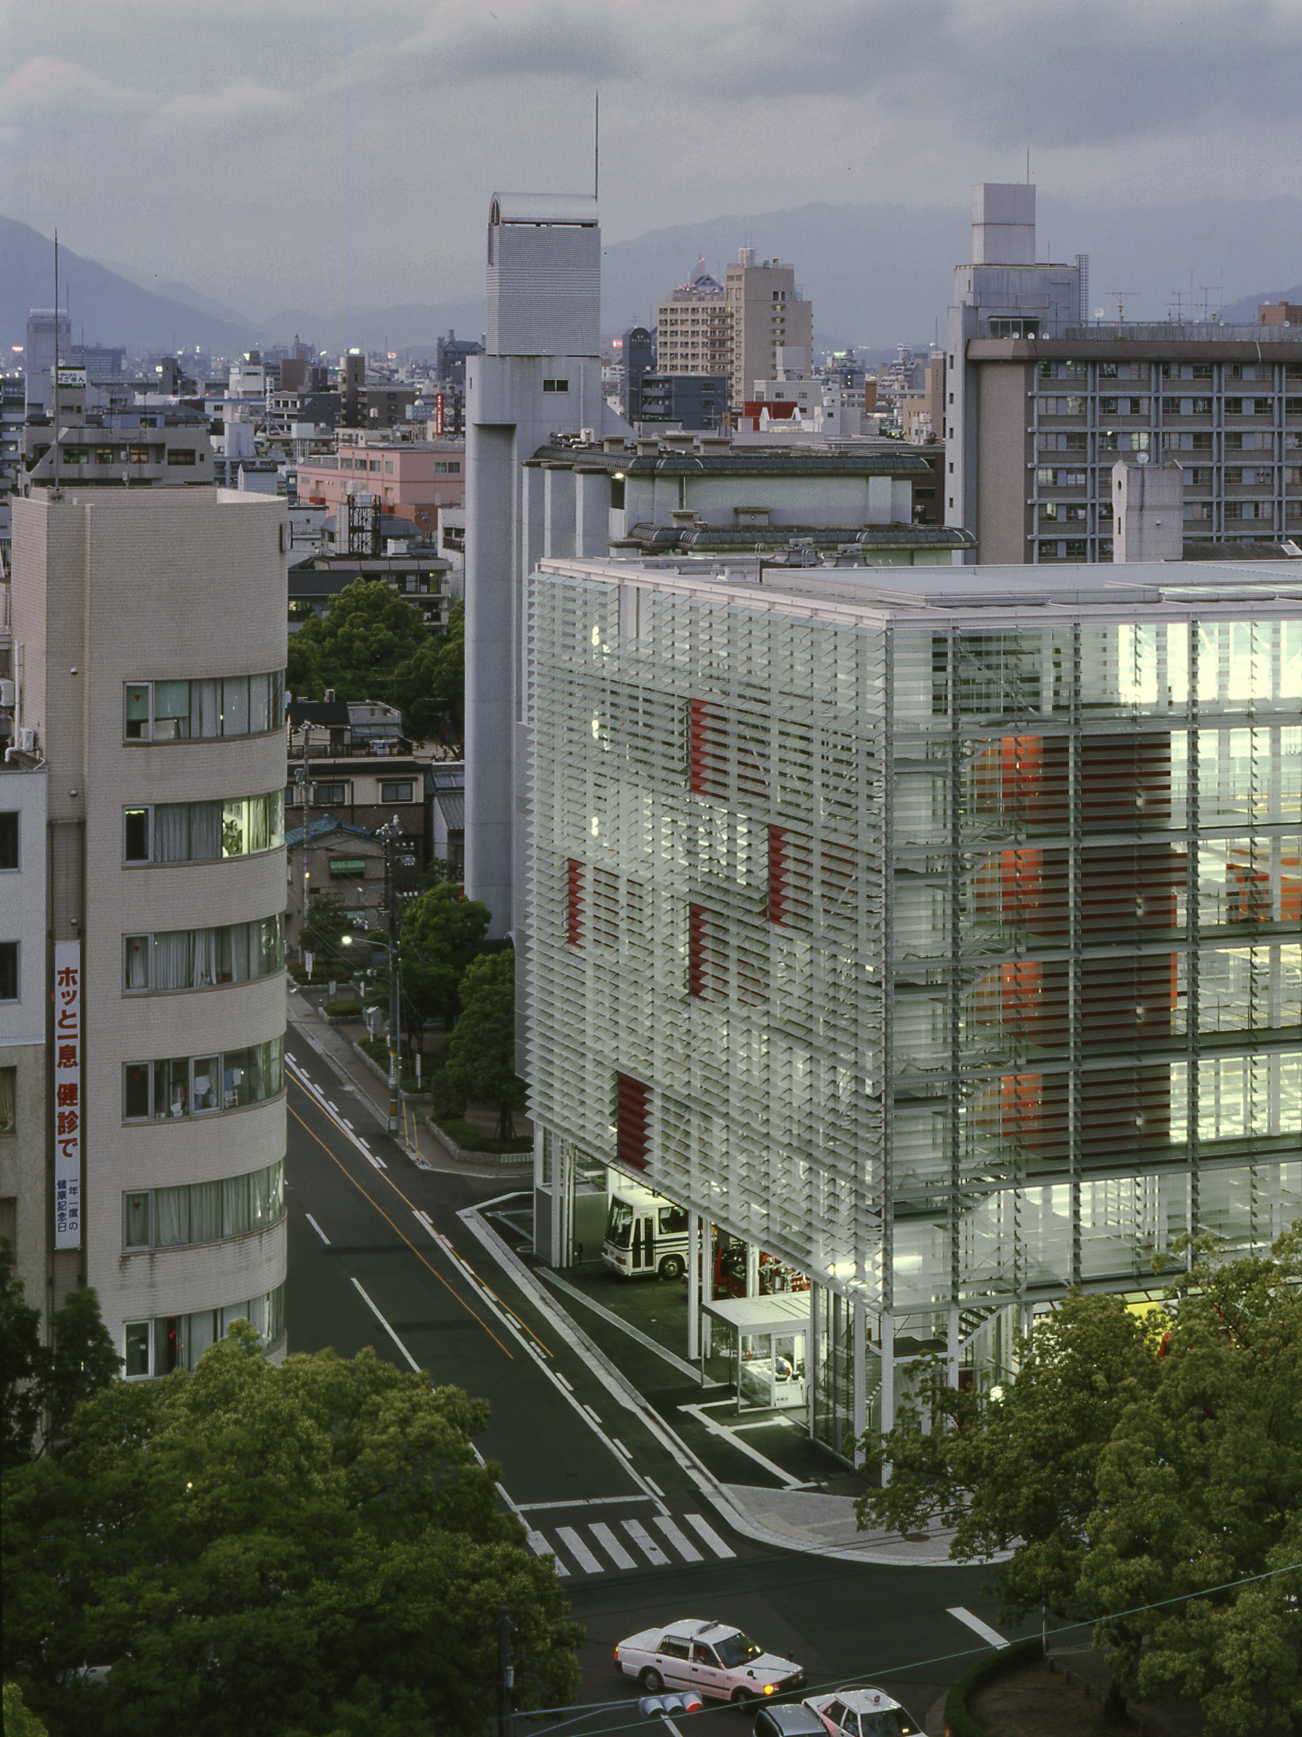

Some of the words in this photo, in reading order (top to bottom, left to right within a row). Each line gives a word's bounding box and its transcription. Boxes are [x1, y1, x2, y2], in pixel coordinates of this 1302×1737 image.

[57, 966, 78, 1069] ホッと一息
[57, 1084, 78, 1158] 健診で
[57, 1179, 67, 1233] 健康記念日
[68, 1179, 78, 1231] 一年一度の
